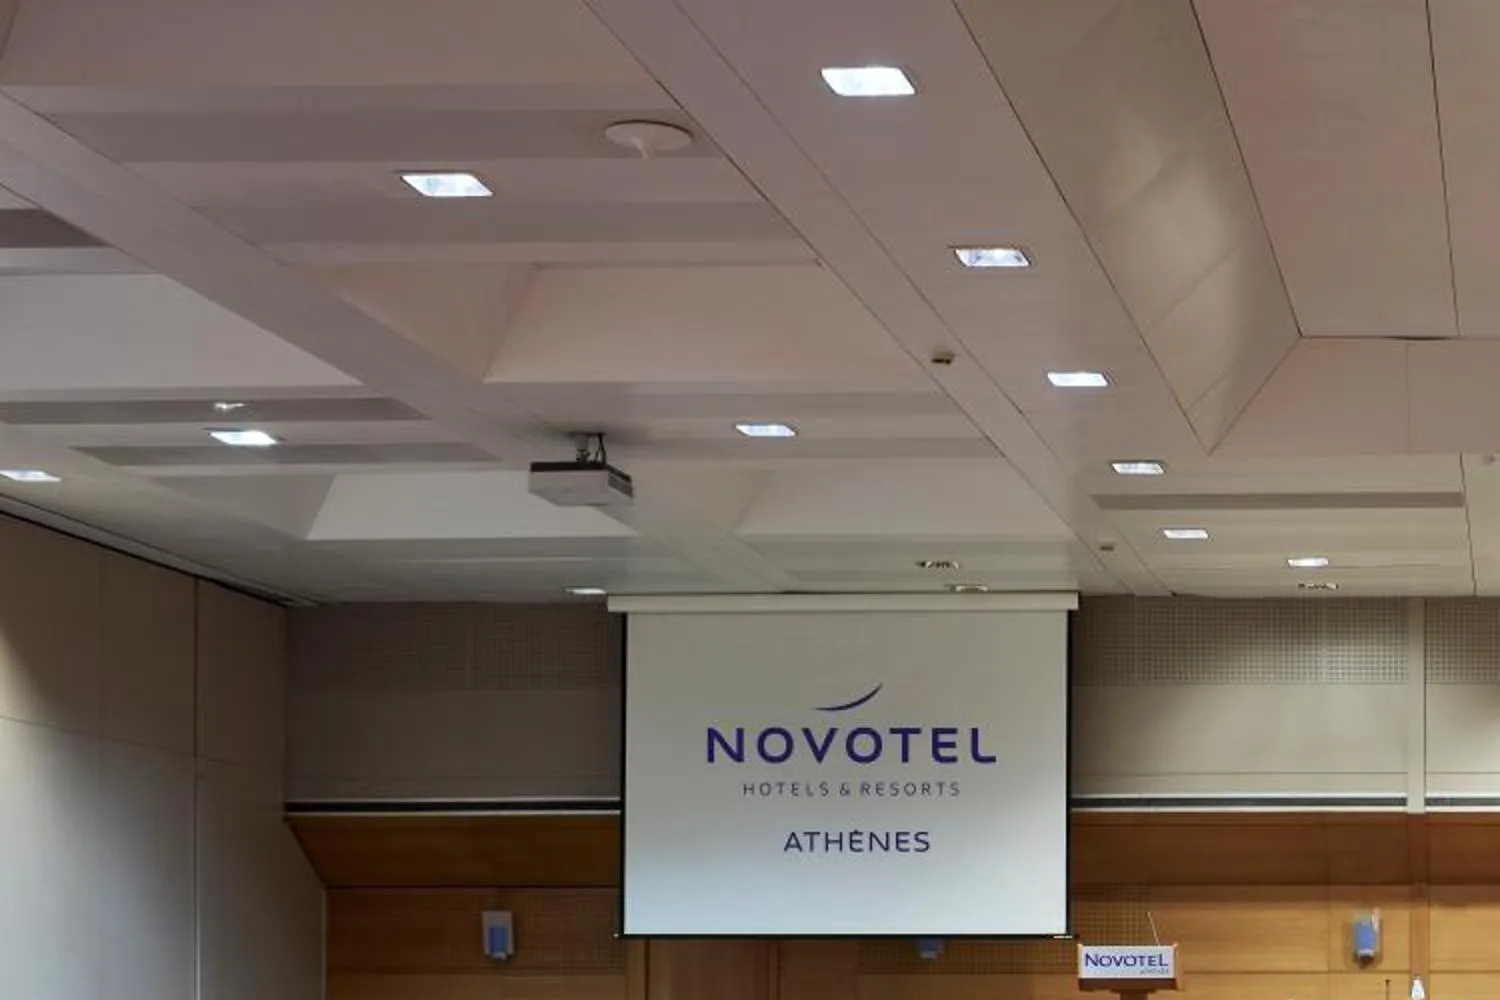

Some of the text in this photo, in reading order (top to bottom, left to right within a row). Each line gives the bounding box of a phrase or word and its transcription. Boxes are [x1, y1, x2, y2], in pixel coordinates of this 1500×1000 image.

[706, 726, 997, 764] NOVOTEL
[743, 781, 961, 797] HOTELS & RESORTS
[1085, 953, 1169, 967] NOVOTEL
